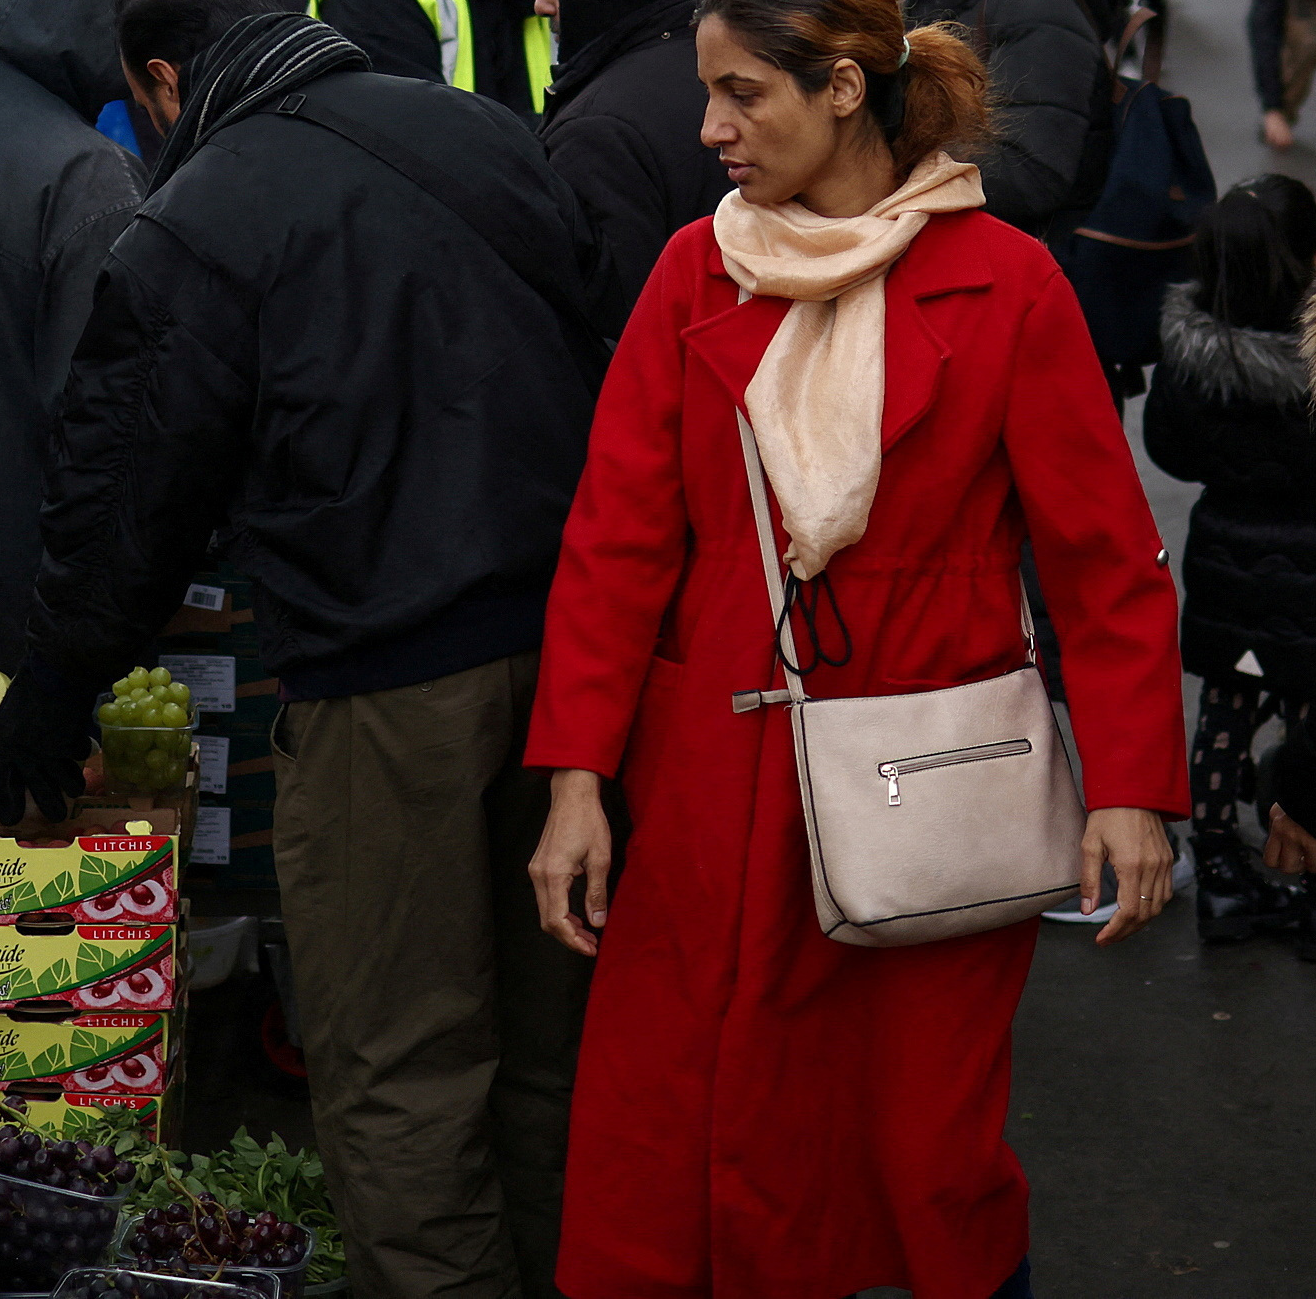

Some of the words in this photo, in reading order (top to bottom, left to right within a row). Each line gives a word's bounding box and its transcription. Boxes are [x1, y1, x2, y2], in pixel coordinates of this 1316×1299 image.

[94, 840, 152, 851] LITCHIS
[93, 929, 152, 940] LITCHIS
[87, 1017, 145, 1027] LITCHIS
